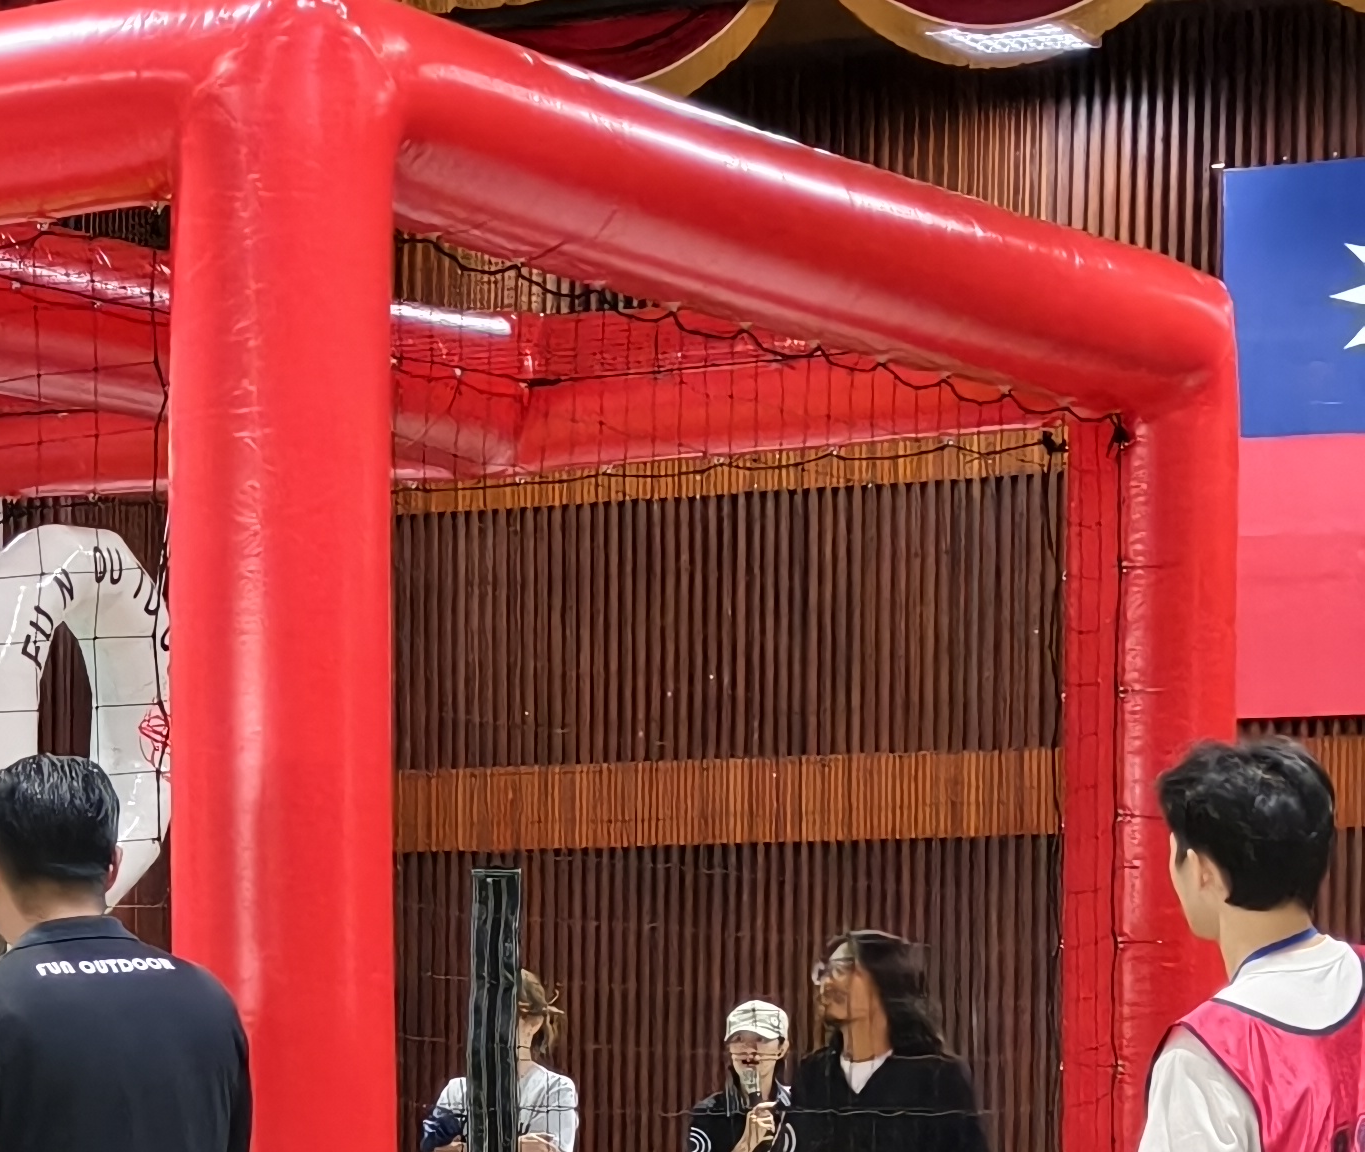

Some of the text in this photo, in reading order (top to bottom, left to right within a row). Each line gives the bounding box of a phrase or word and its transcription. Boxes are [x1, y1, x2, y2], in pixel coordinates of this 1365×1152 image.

[22, 568, 74, 671] FUN
[35, 957, 176, 977] FUN OUTDOOR
